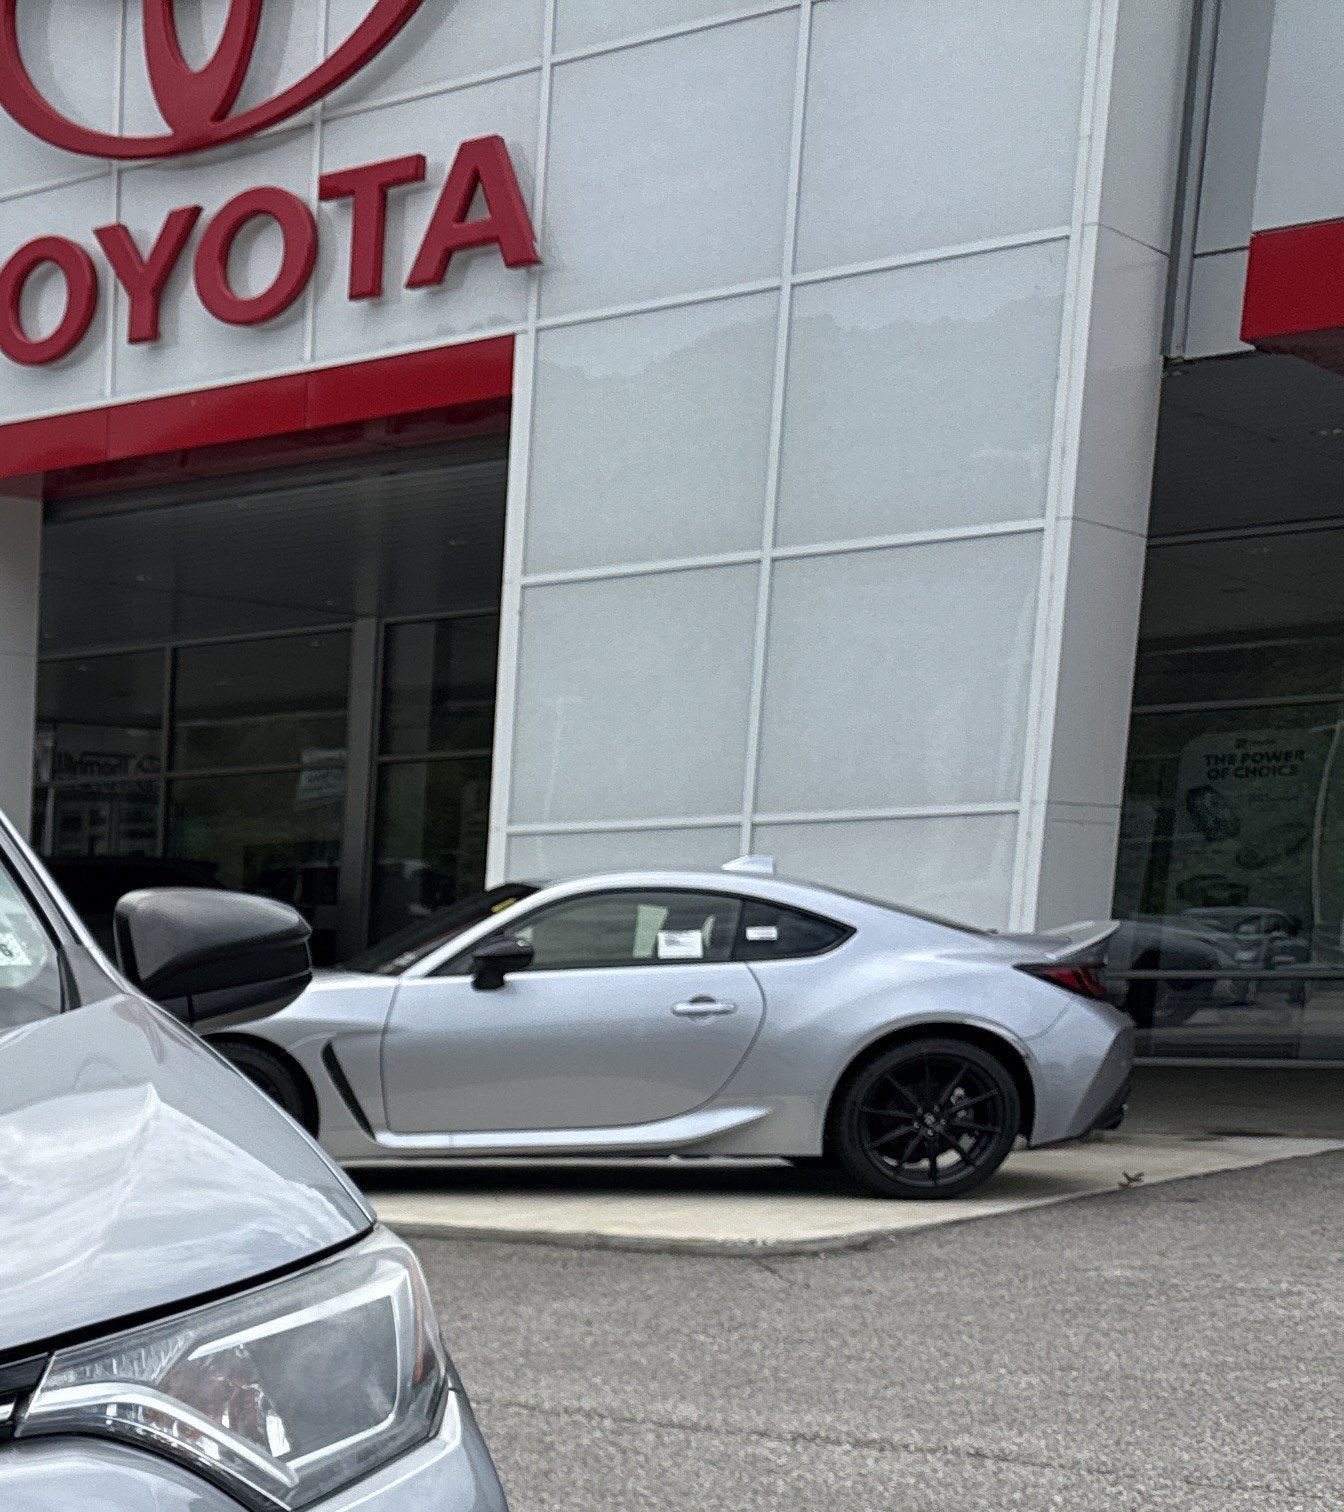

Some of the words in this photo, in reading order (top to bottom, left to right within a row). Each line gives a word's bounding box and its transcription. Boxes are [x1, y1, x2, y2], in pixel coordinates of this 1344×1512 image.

[1203, 754, 1235, 765] THE
[1241, 750, 1307, 764] POWER
[1207, 767, 1230, 778] OF
[1234, 764, 1298, 778] CHOICE
